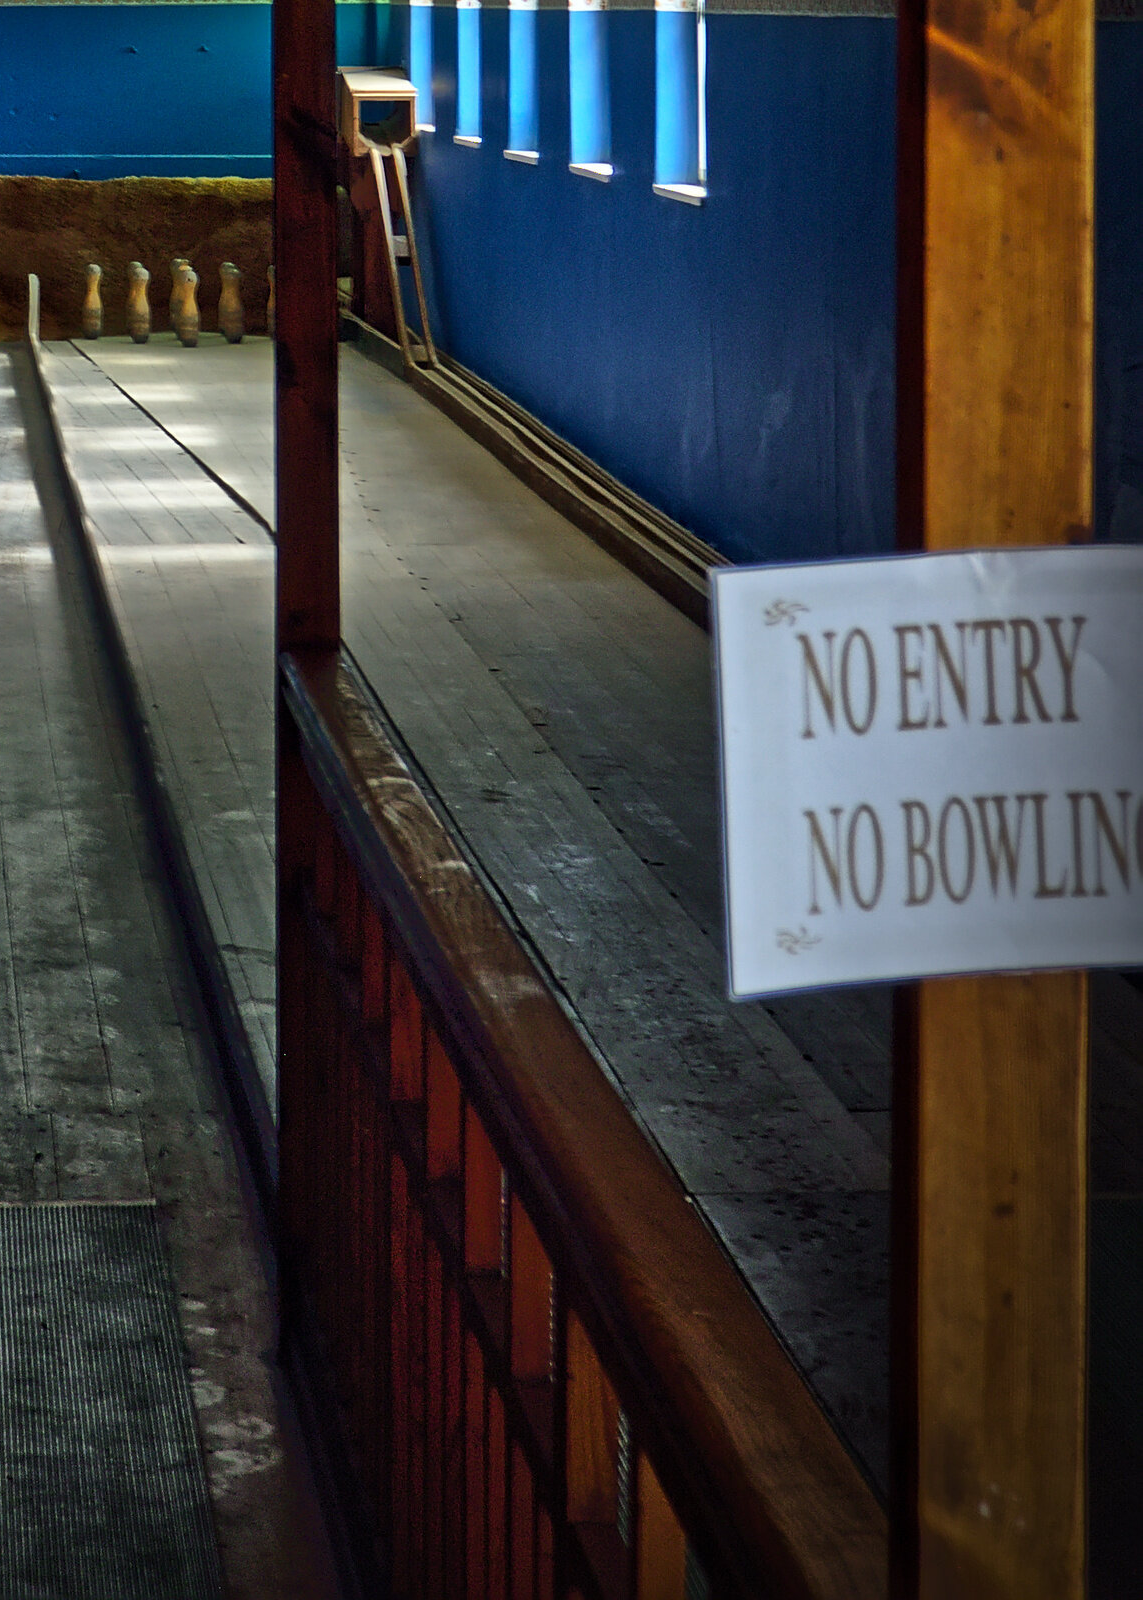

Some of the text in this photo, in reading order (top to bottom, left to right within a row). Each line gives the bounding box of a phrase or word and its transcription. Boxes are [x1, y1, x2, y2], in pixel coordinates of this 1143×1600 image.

[795, 616, 1088, 739] NO ENTRY
[803, 790, 1143, 916] NO BOWLIN
